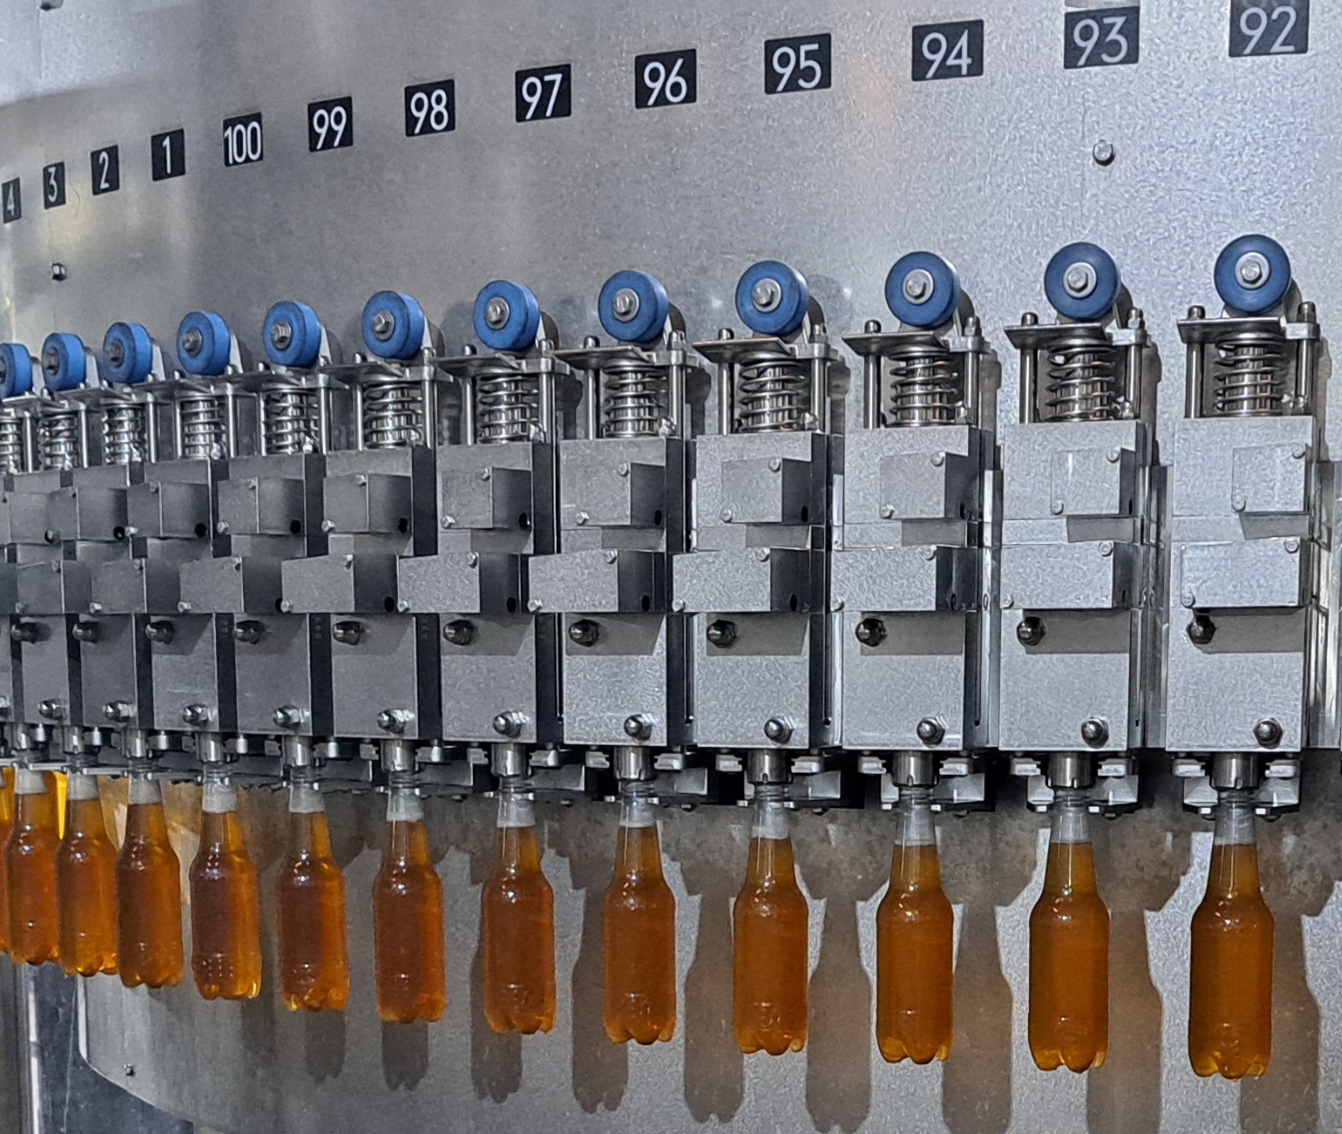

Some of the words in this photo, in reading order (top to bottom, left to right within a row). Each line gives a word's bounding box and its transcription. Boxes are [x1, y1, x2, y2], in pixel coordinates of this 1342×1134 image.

[1073, 16, 1128, 67] 93
[1239, 5, 1297, 55] 92
[772, 43, 822, 92] 95
[921, 29, 972, 79] 94
[521, 73, 563, 120] 97
[643, 58, 688, 106] 96
[312, 105, 347, 150] 99
[410, 88, 449, 134] 98
[162, 135, 172, 174] 1
[223, 121, 262, 165] 100
[47, 166, 58, 203] 3
[98, 150, 110, 190] 2
[6, 183, 15, 216] 4
